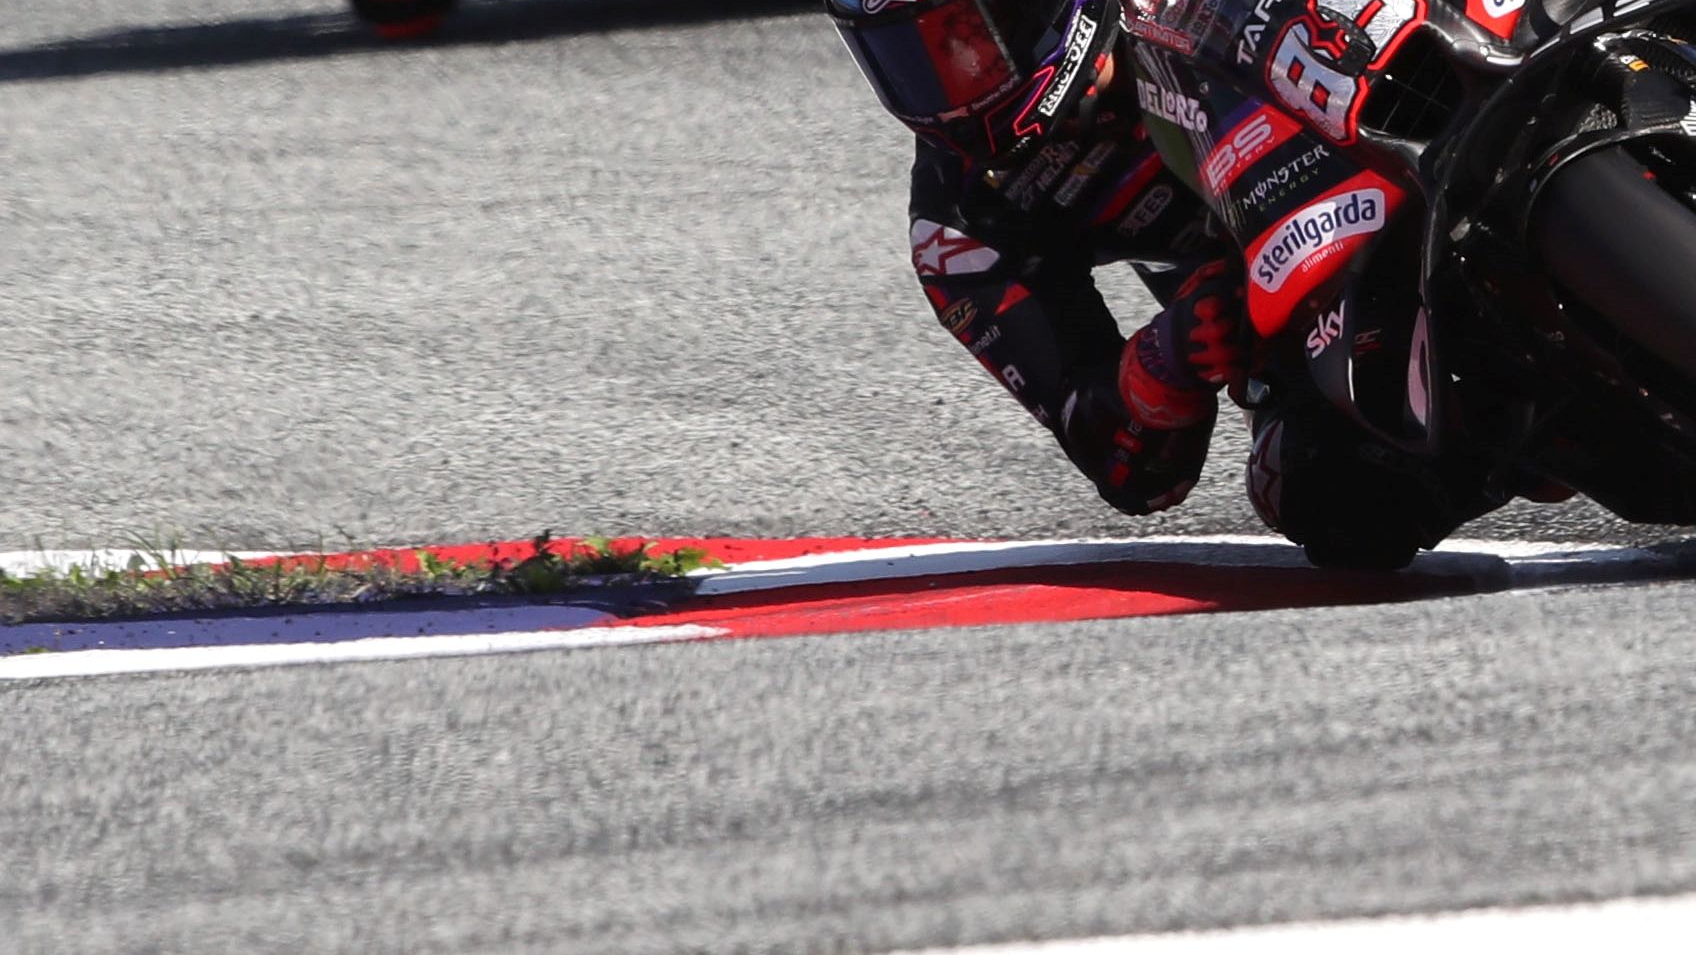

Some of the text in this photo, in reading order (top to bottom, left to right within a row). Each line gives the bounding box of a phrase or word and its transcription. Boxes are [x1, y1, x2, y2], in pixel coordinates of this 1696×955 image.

[1206, 112, 1273, 189] BS
[1241, 143, 1331, 212] MONSTER
[1257, 192, 1377, 285] sterilgarda
[1306, 299, 1346, 359] sky
